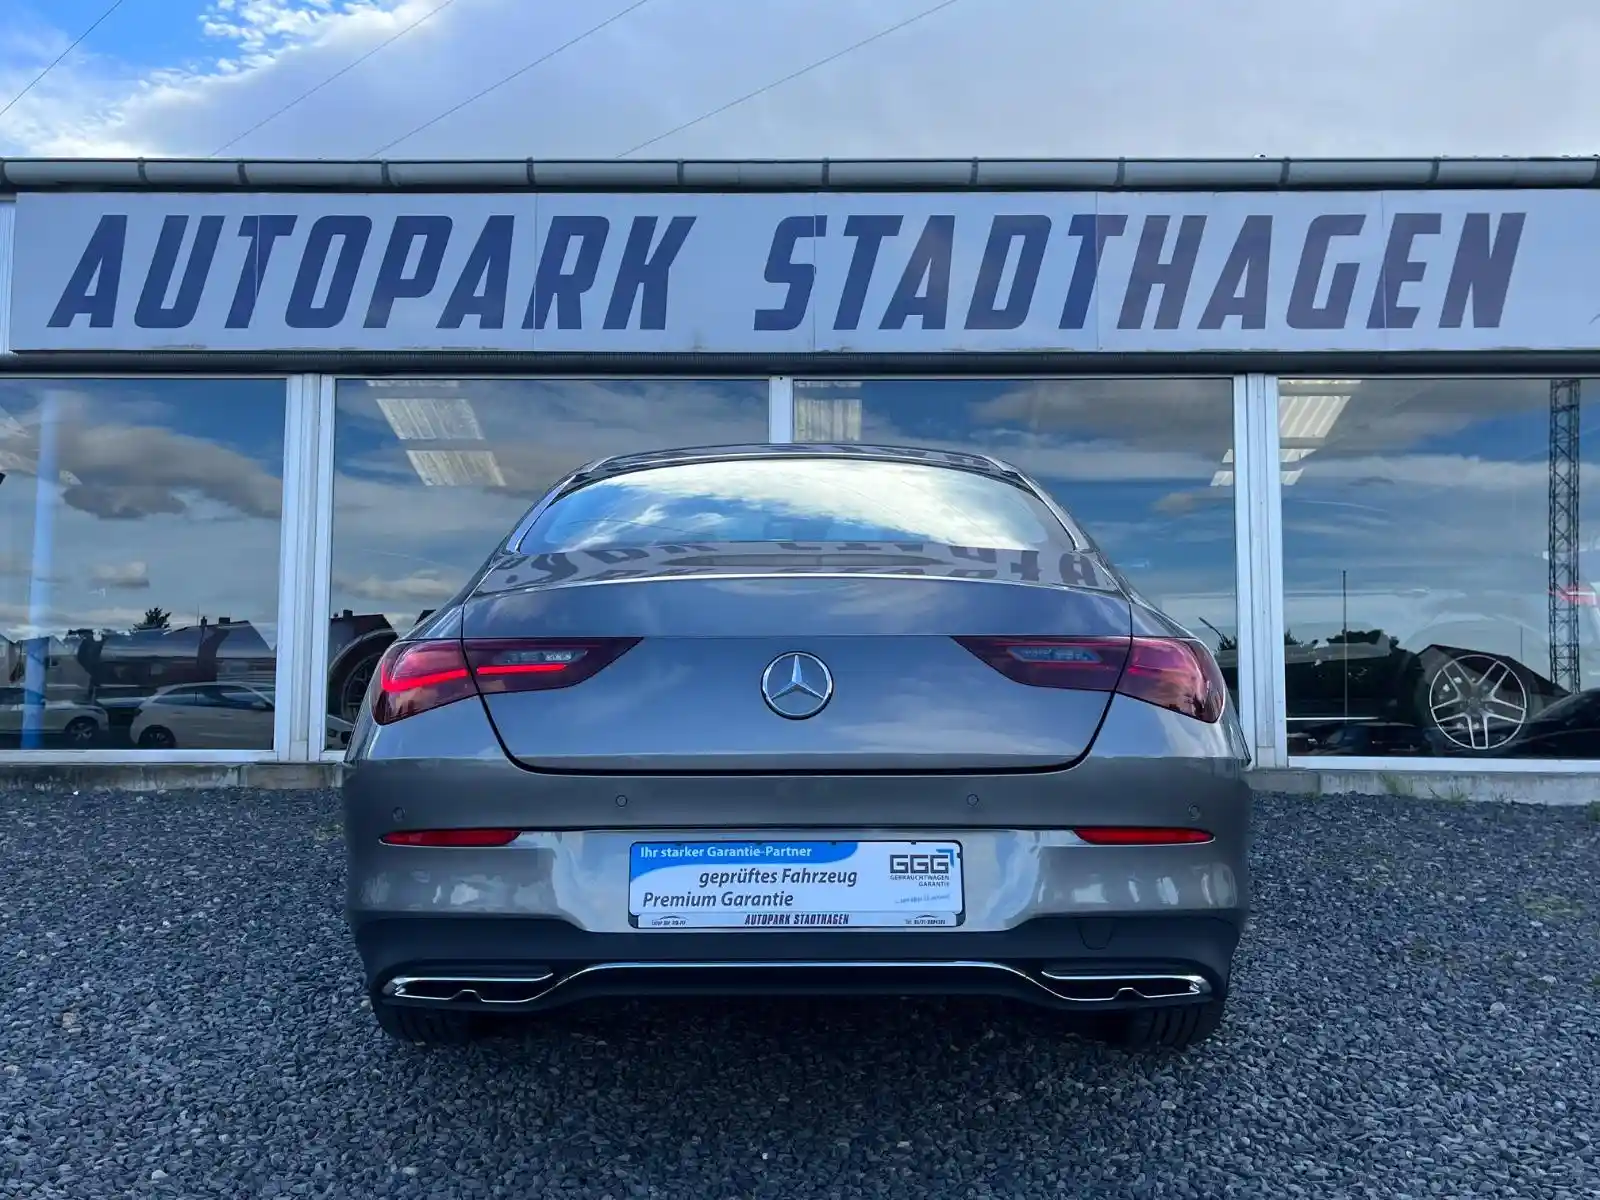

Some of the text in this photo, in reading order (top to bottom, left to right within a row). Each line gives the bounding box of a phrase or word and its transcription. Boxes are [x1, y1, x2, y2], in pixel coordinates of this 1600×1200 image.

[47, 212, 1527, 331] AUTOPARK STADTHAGEN
[640, 845, 812, 858] Ihr starker Garantie-Partner
[889, 854, 949, 874] GGG
[699, 867, 858, 888] geprüftes Fahrzeug
[642, 891, 794, 907] Premium Garantie
[744, 913, 850, 925] AUTOPARK STADTHAGEN
